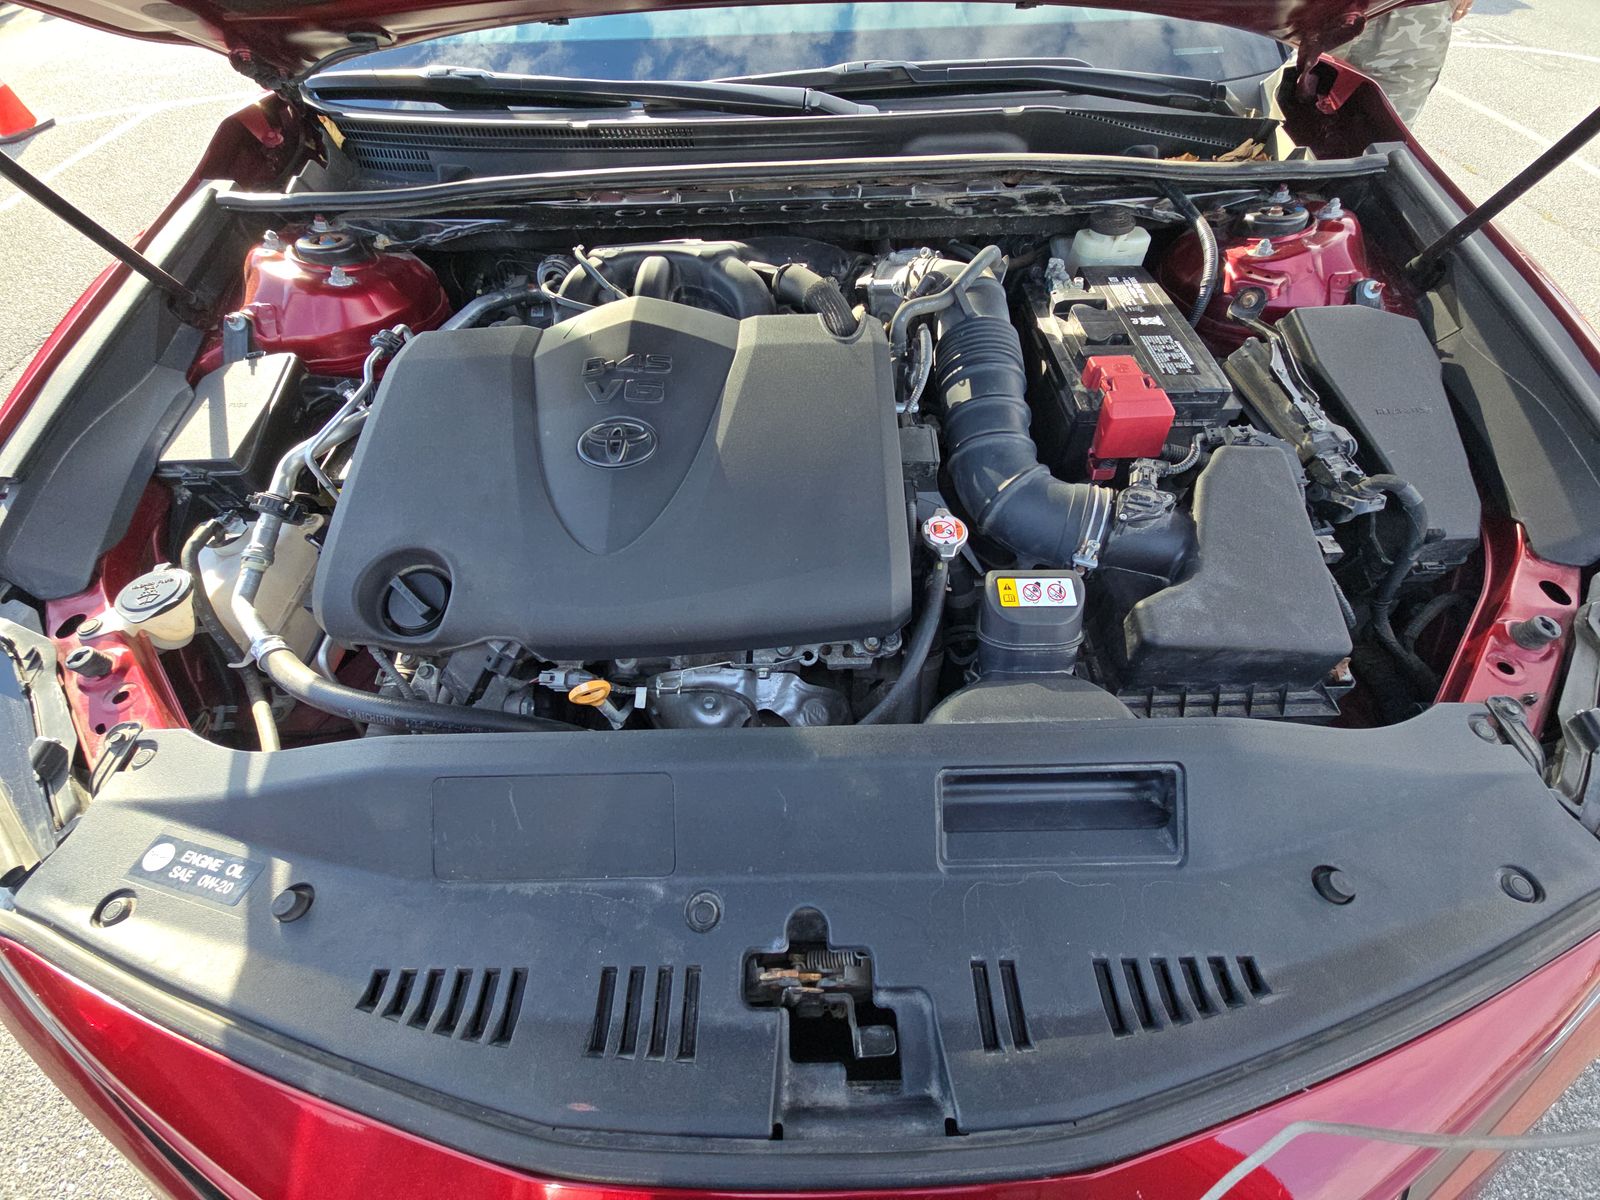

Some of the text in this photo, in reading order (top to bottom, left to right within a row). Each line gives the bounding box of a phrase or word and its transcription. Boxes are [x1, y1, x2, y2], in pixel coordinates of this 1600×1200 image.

[584, 379, 664, 404] V6
[180, 850, 246, 879] ENGINE OIL
[168, 865, 235, 895] SAE 0W-20
